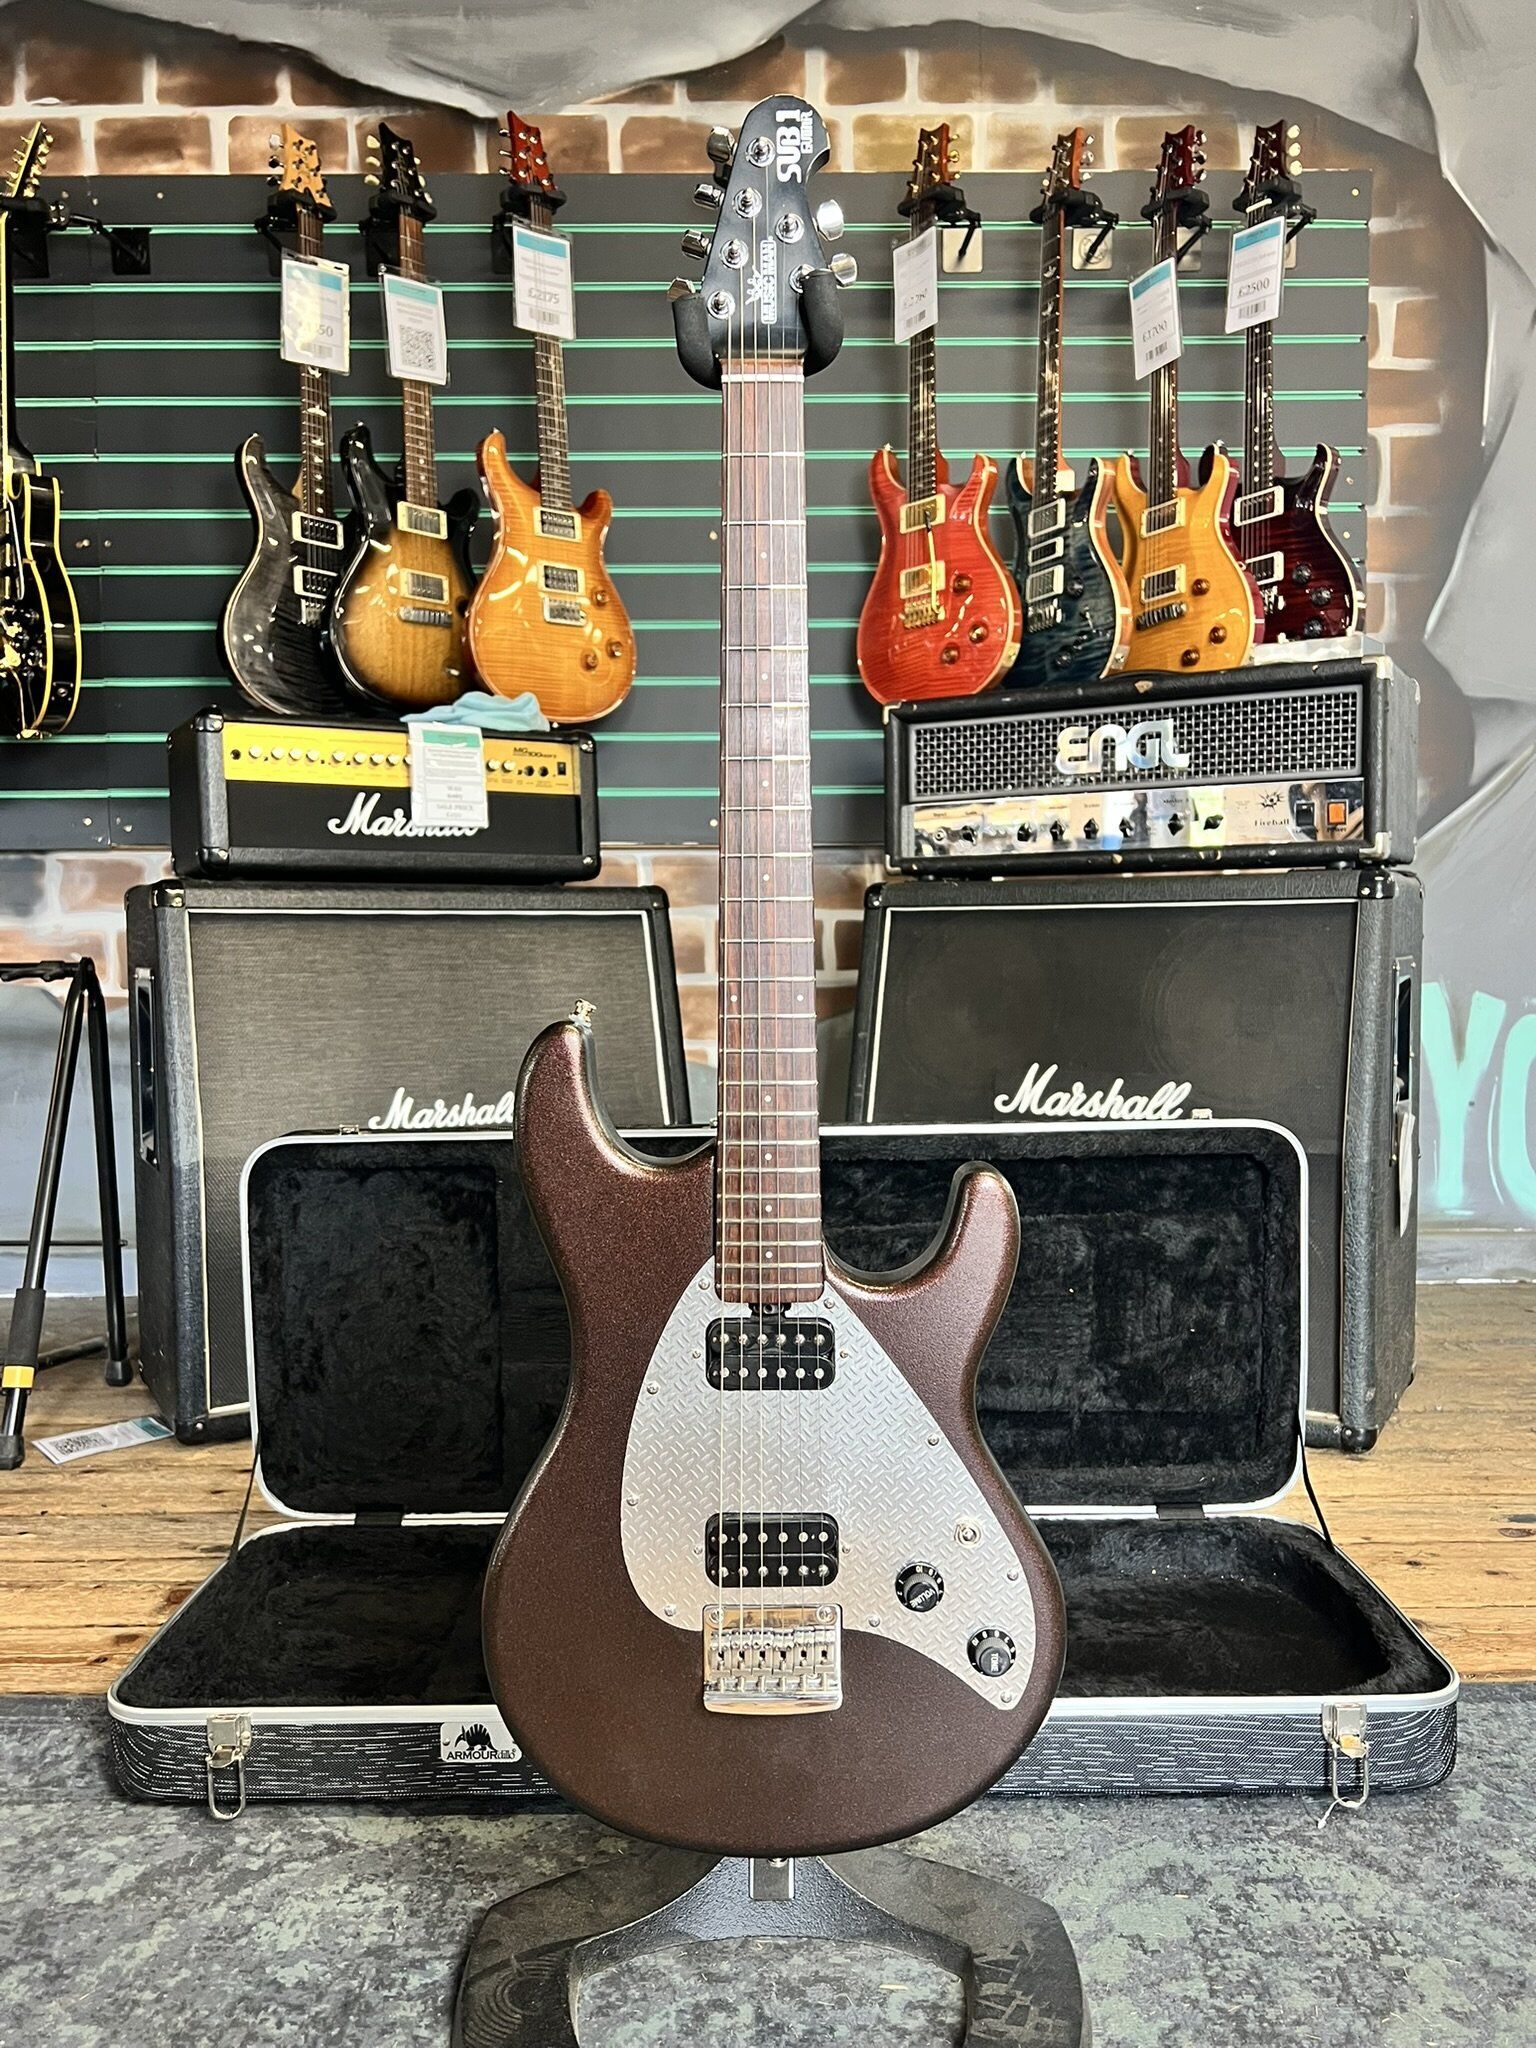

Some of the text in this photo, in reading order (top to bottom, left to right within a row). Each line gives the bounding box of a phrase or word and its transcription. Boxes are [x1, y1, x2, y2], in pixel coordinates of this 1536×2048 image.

[776, 109, 802, 184] SUB 1
[528, 287, 560, 304] £2175
[762, 244, 775, 321] MUSIC MAN
[1238, 277, 1270, 298] £2500
[1055, 718, 1191, 775] ENGL
[368, 1087, 514, 1130] Marshal
[994, 1062, 1192, 1120] Marshall
[909, 1588, 936, 1608] VOLUME
[990, 1652, 999, 1672] TONE
